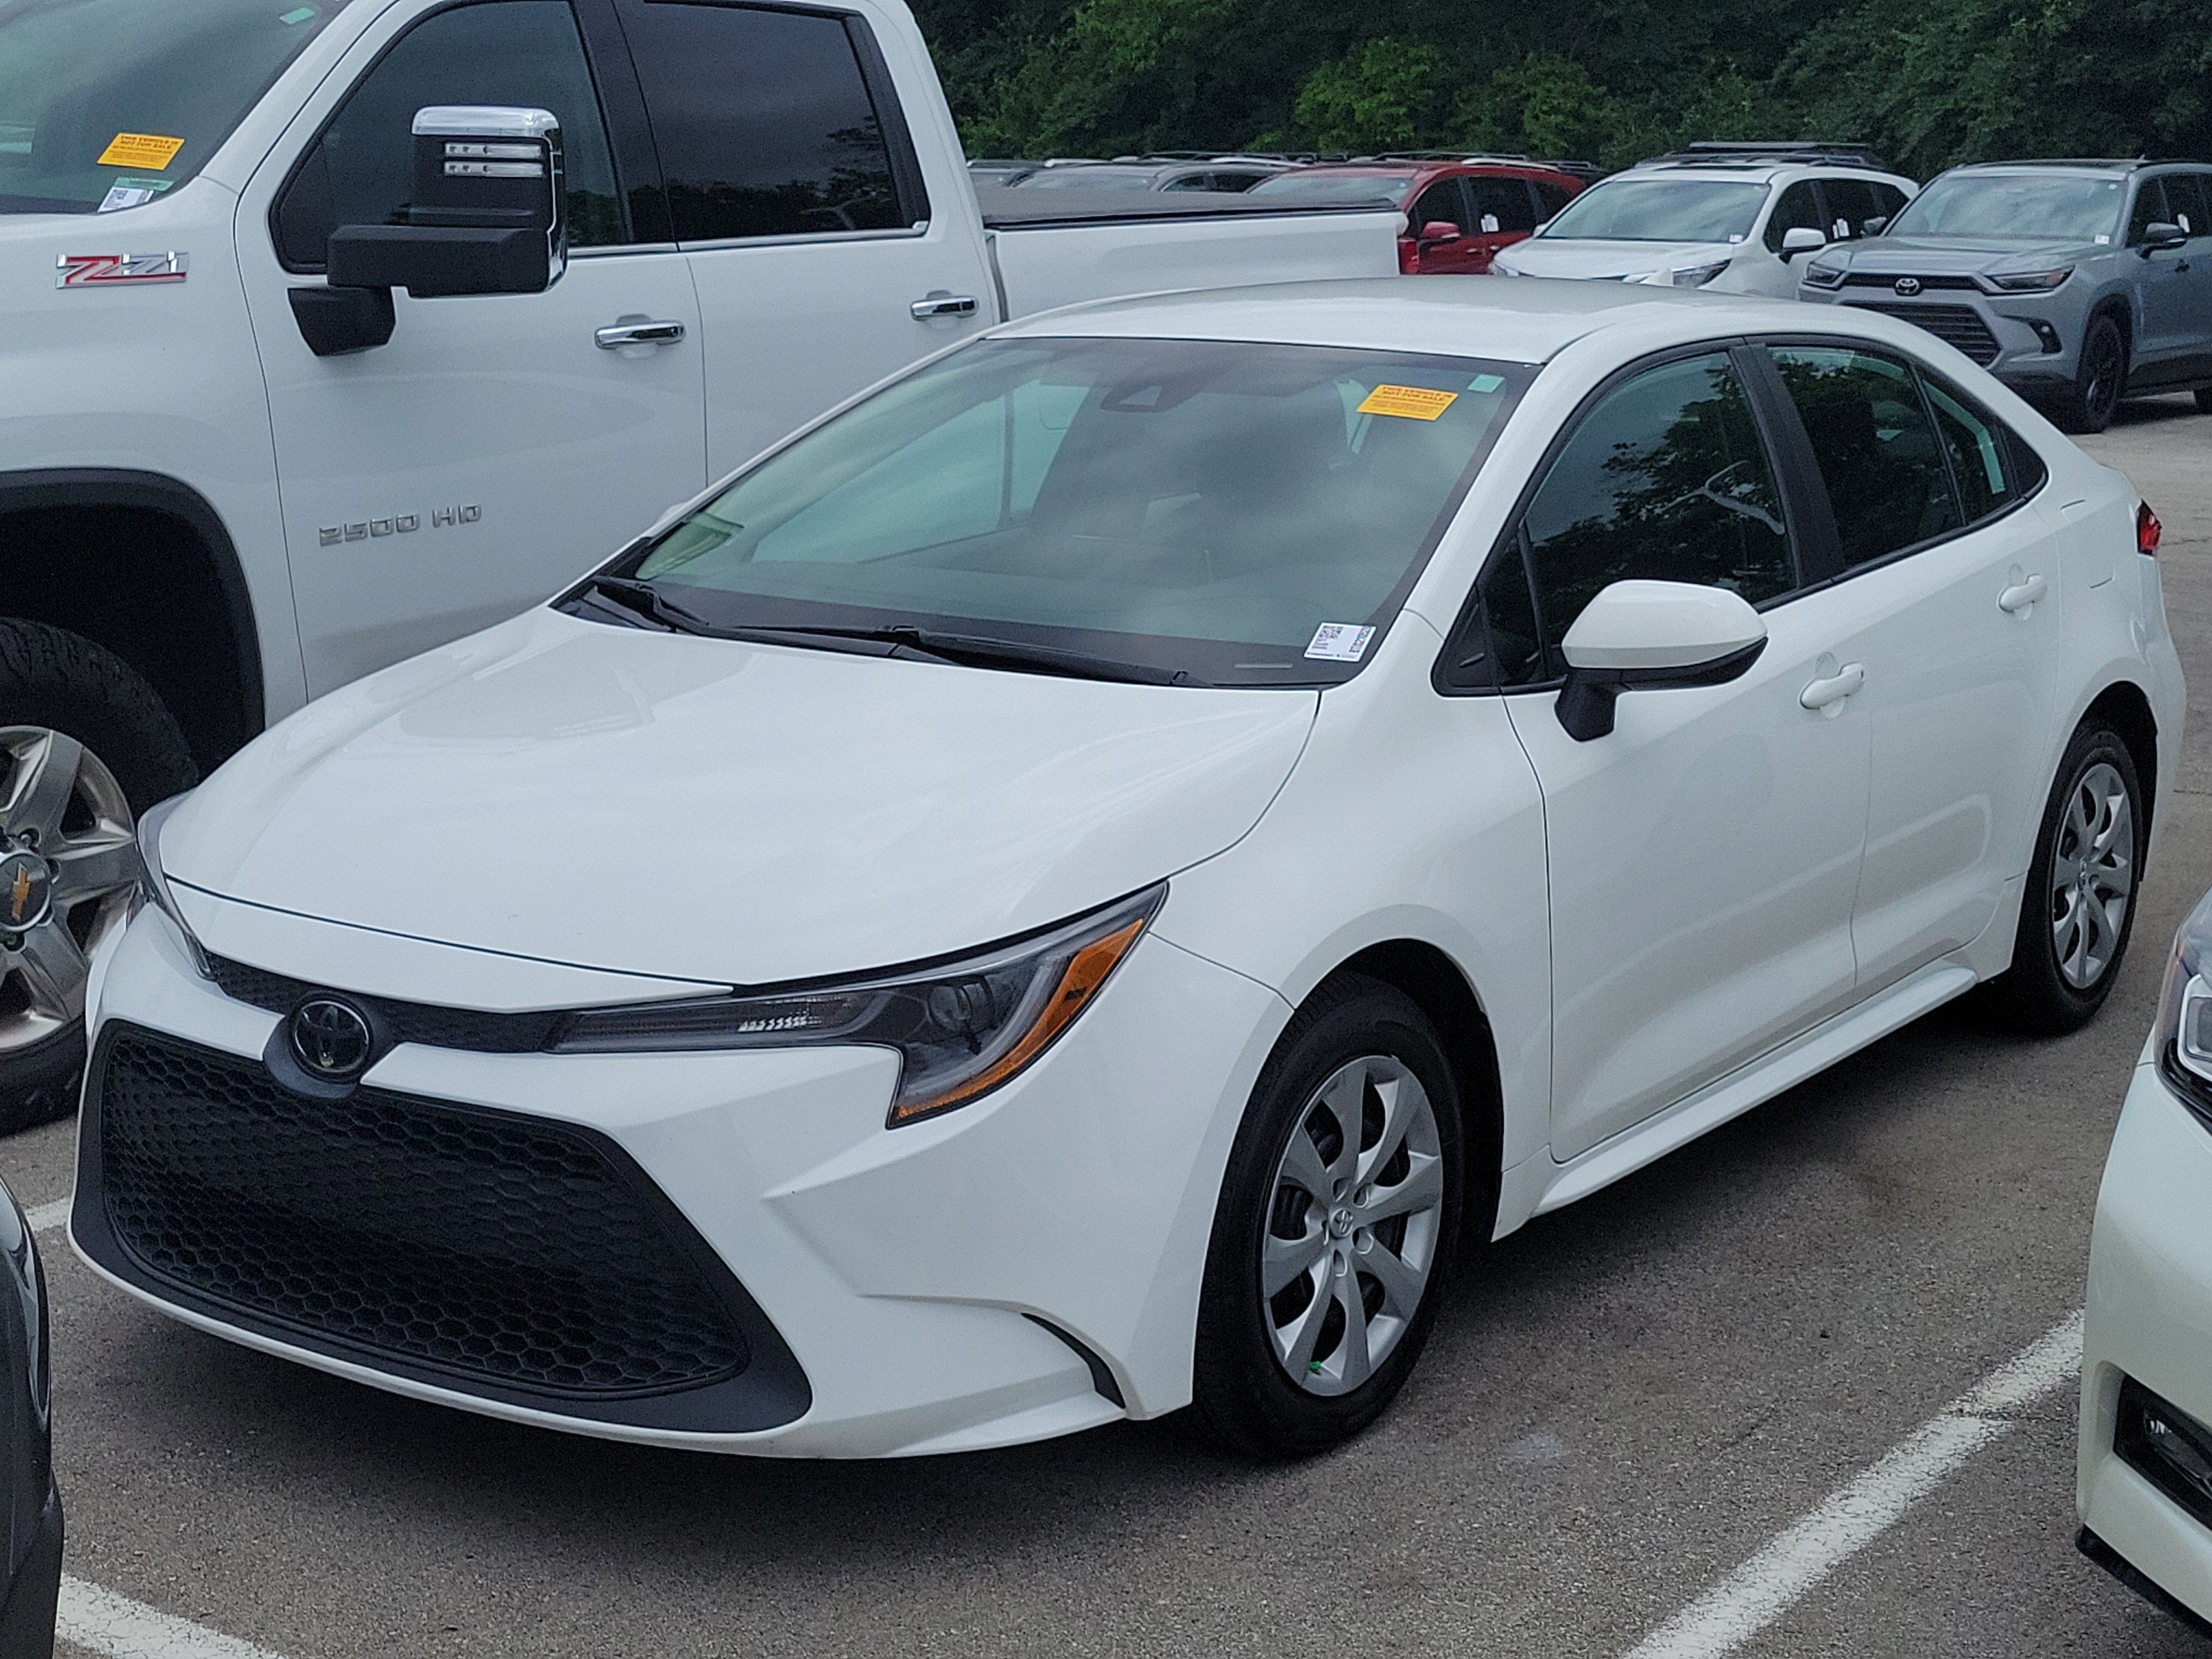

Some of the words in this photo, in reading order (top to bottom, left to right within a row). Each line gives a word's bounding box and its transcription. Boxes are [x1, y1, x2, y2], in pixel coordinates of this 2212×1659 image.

[56, 251, 189, 289] Z71
[319, 514, 420, 547] 2500
[432, 503, 482, 528] HD
